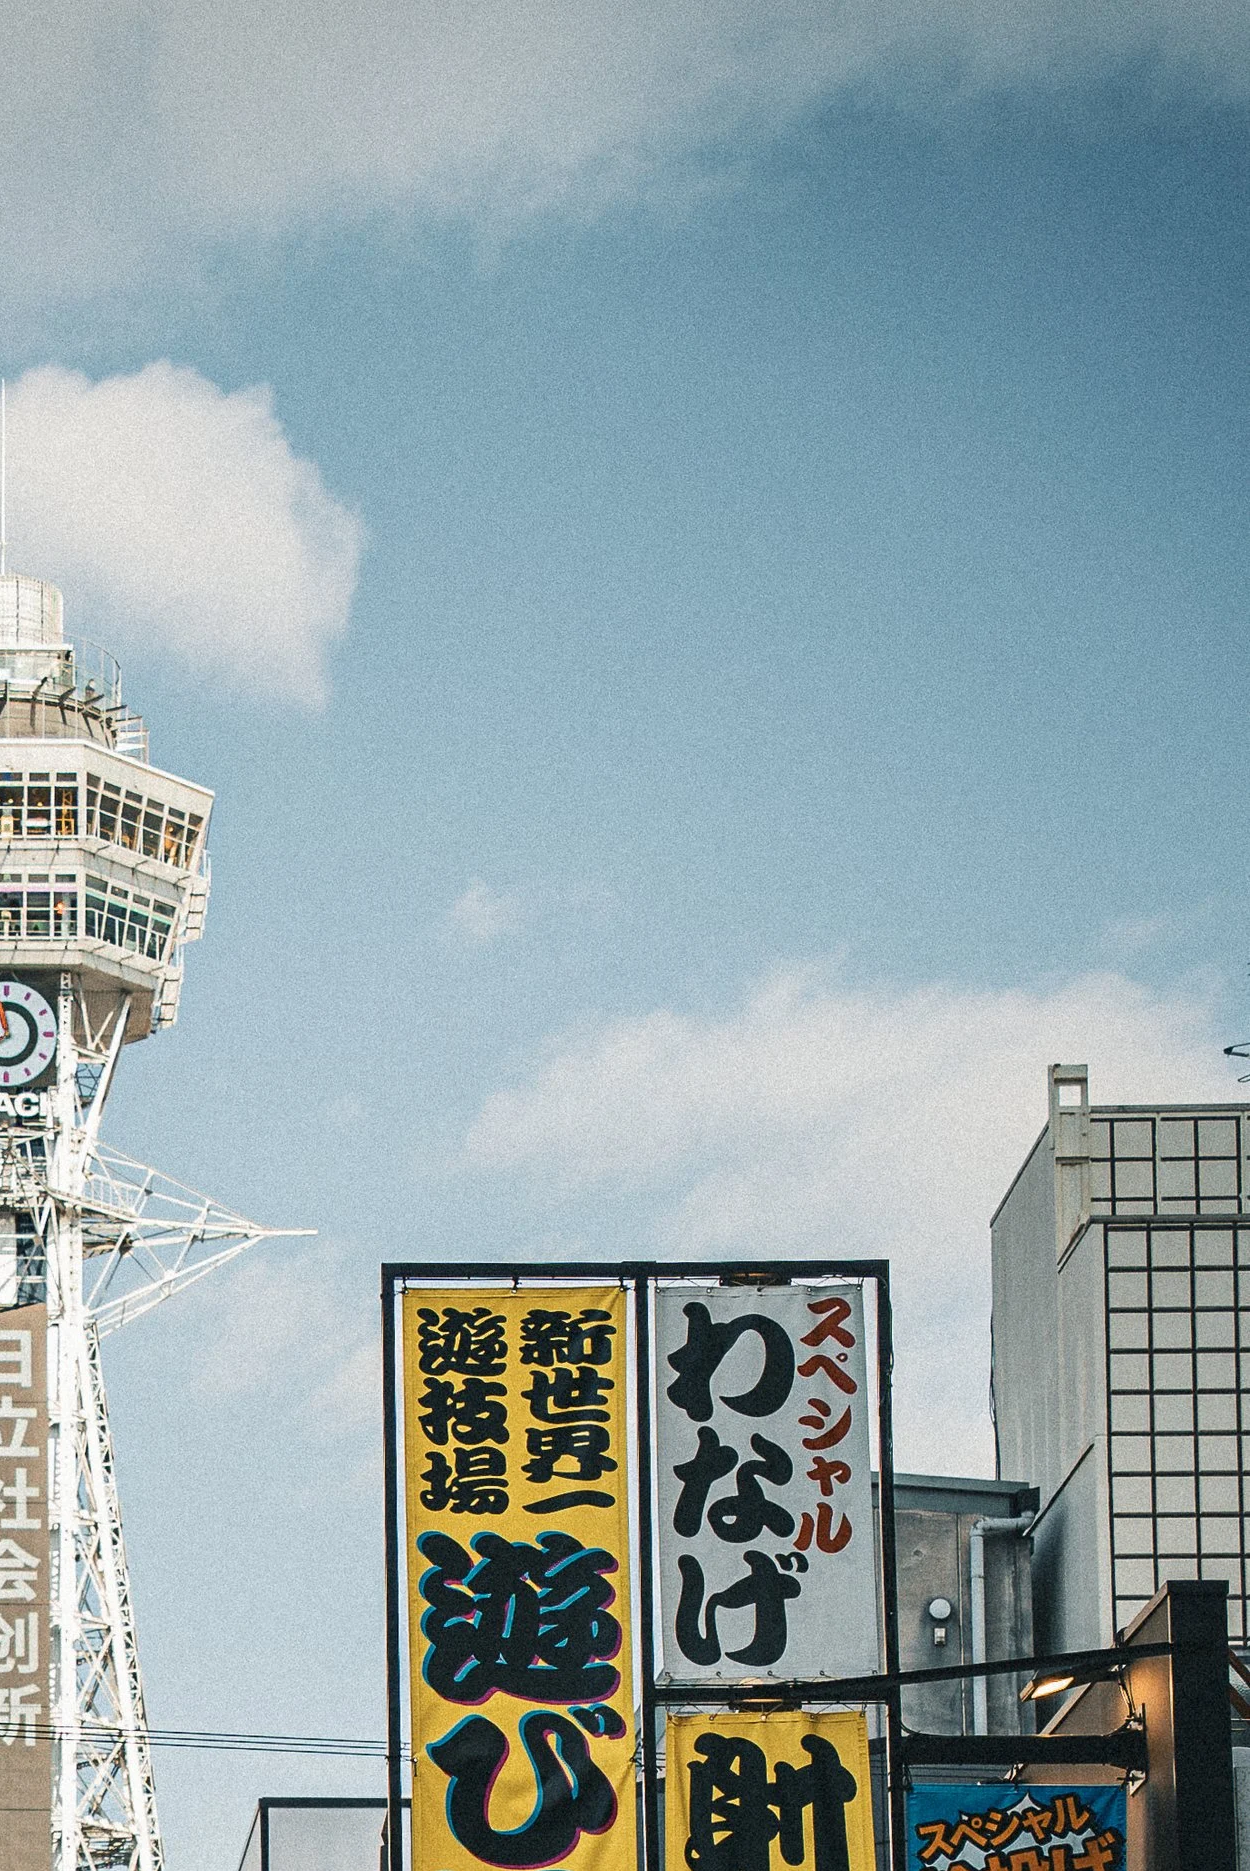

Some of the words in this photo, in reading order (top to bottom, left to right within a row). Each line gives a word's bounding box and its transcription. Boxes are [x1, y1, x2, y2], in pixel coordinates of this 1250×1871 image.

[417, 1307, 510, 1515] 遊技場
[520, 1308, 618, 1515] 新世界一
[666, 1301, 808, 1666] わなげ
[793, 1297, 857, 1554] スペシャル
[917, 1795, 1090, 1861] スペシャル
